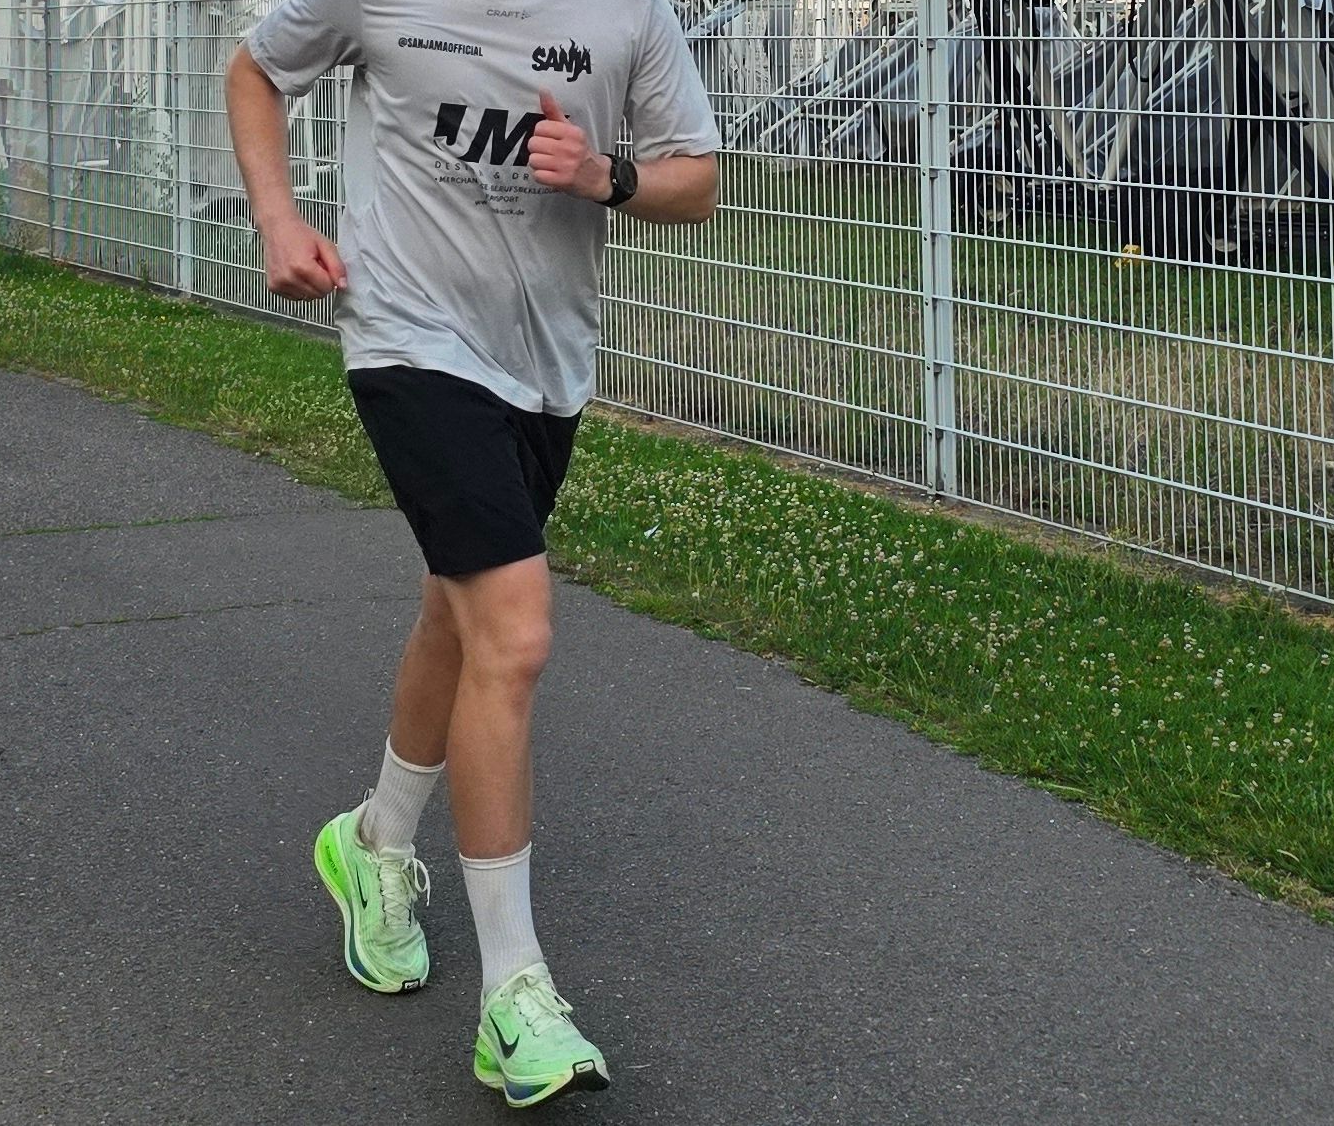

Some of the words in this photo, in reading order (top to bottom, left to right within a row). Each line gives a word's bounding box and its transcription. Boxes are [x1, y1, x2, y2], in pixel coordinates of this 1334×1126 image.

[486, 9, 520, 19] CRAFT
[397, 37, 484, 57] @SANJAMAOFFICIAL
[531, 38, 593, 83] SANJA
[434, 160, 484, 177] DESI
[493, 171, 500, 180] &
